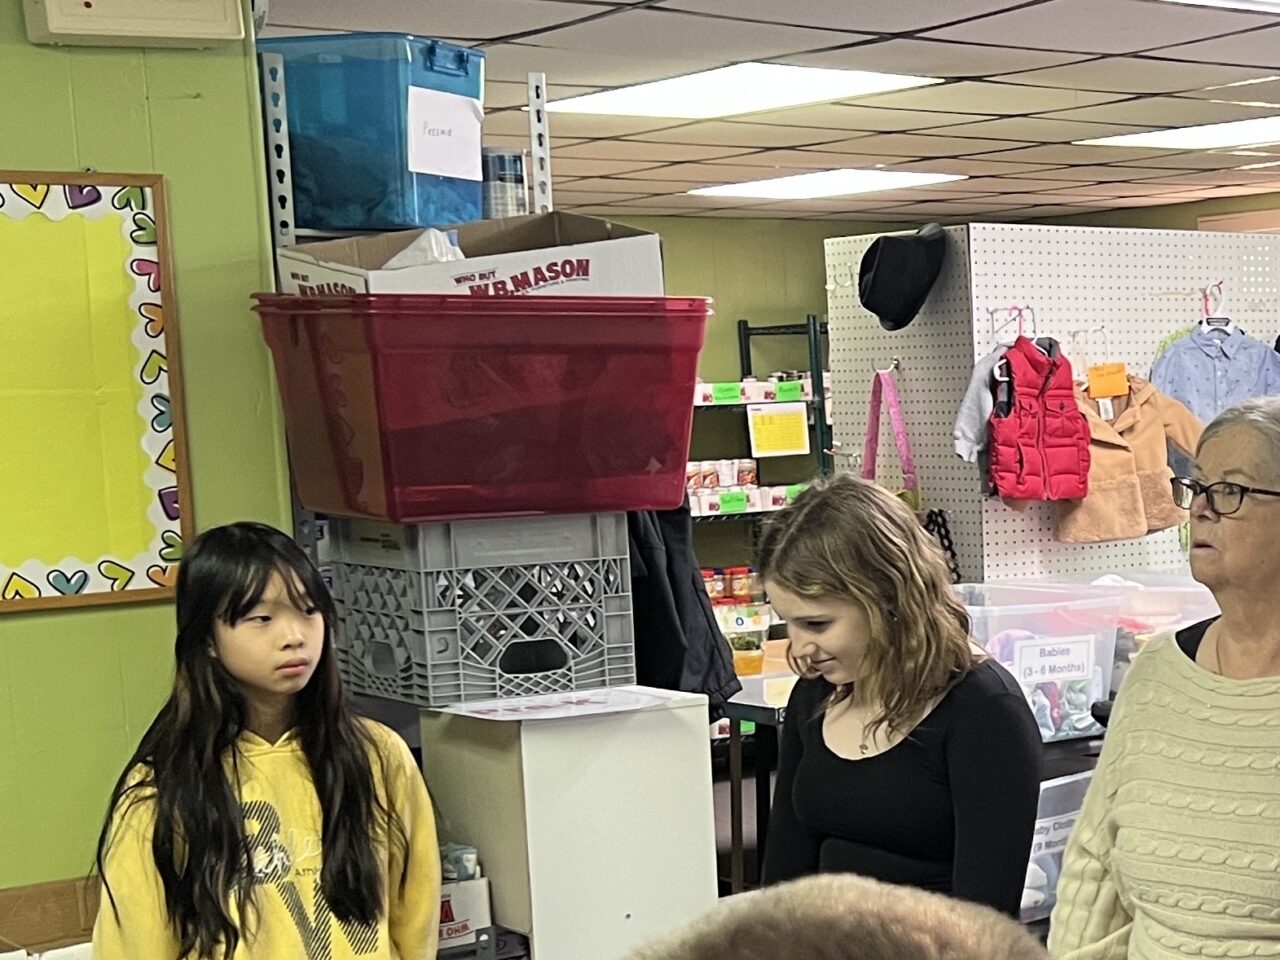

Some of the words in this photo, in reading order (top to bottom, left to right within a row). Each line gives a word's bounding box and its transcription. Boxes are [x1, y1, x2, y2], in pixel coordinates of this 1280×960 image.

[454, 272, 477, 285] WHO
[478, 270, 497, 281] BUT
[1039, 646, 1071, 658] Babies
[1023, 666, 1033, 679] (3
[1040, 665, 1046, 675] 6
[1048, 661, 1086, 674] Months)
